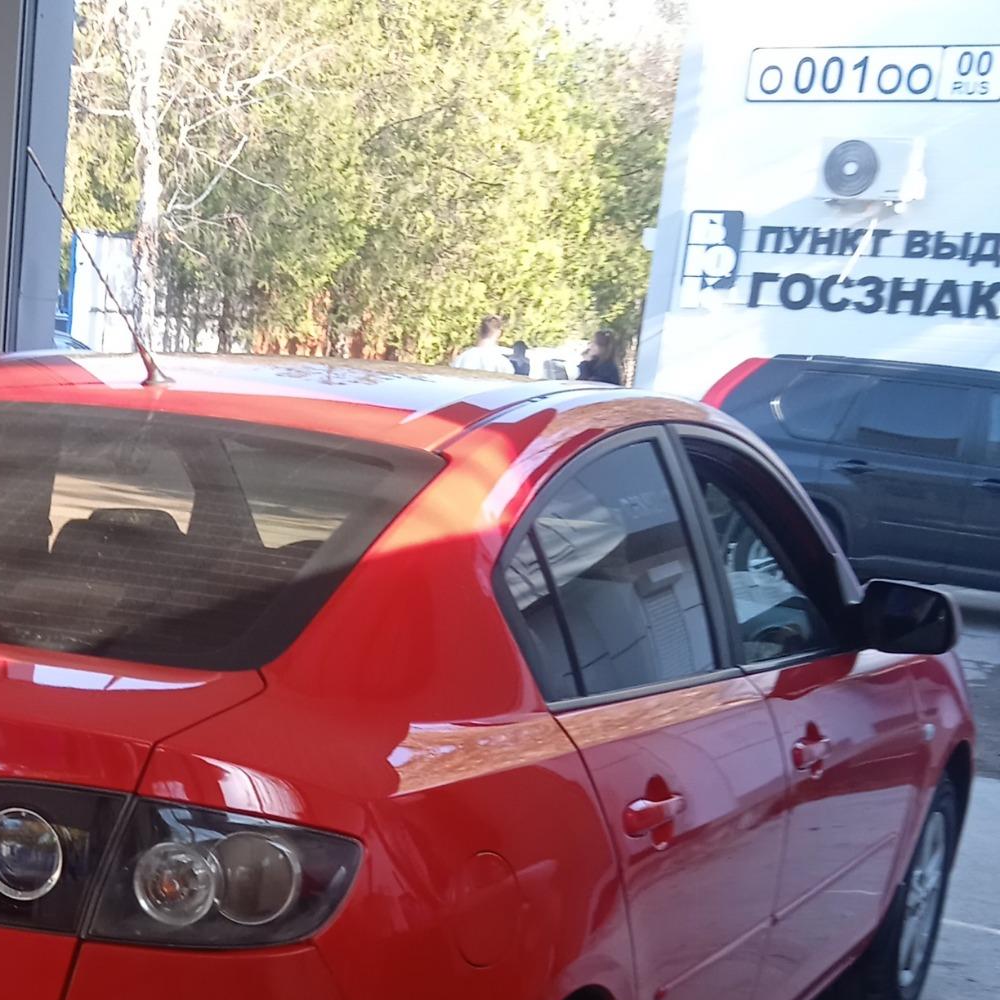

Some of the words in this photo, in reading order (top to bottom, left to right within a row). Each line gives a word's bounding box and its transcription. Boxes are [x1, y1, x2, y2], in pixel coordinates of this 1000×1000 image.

[958, 51, 992, 76] 00
[952, 81, 990, 95] RUS
[757, 226, 892, 258] ПУНКТ
[903, 230, 1000, 268] ВЫД
[747, 272, 1000, 319] ГОСЗНАК
